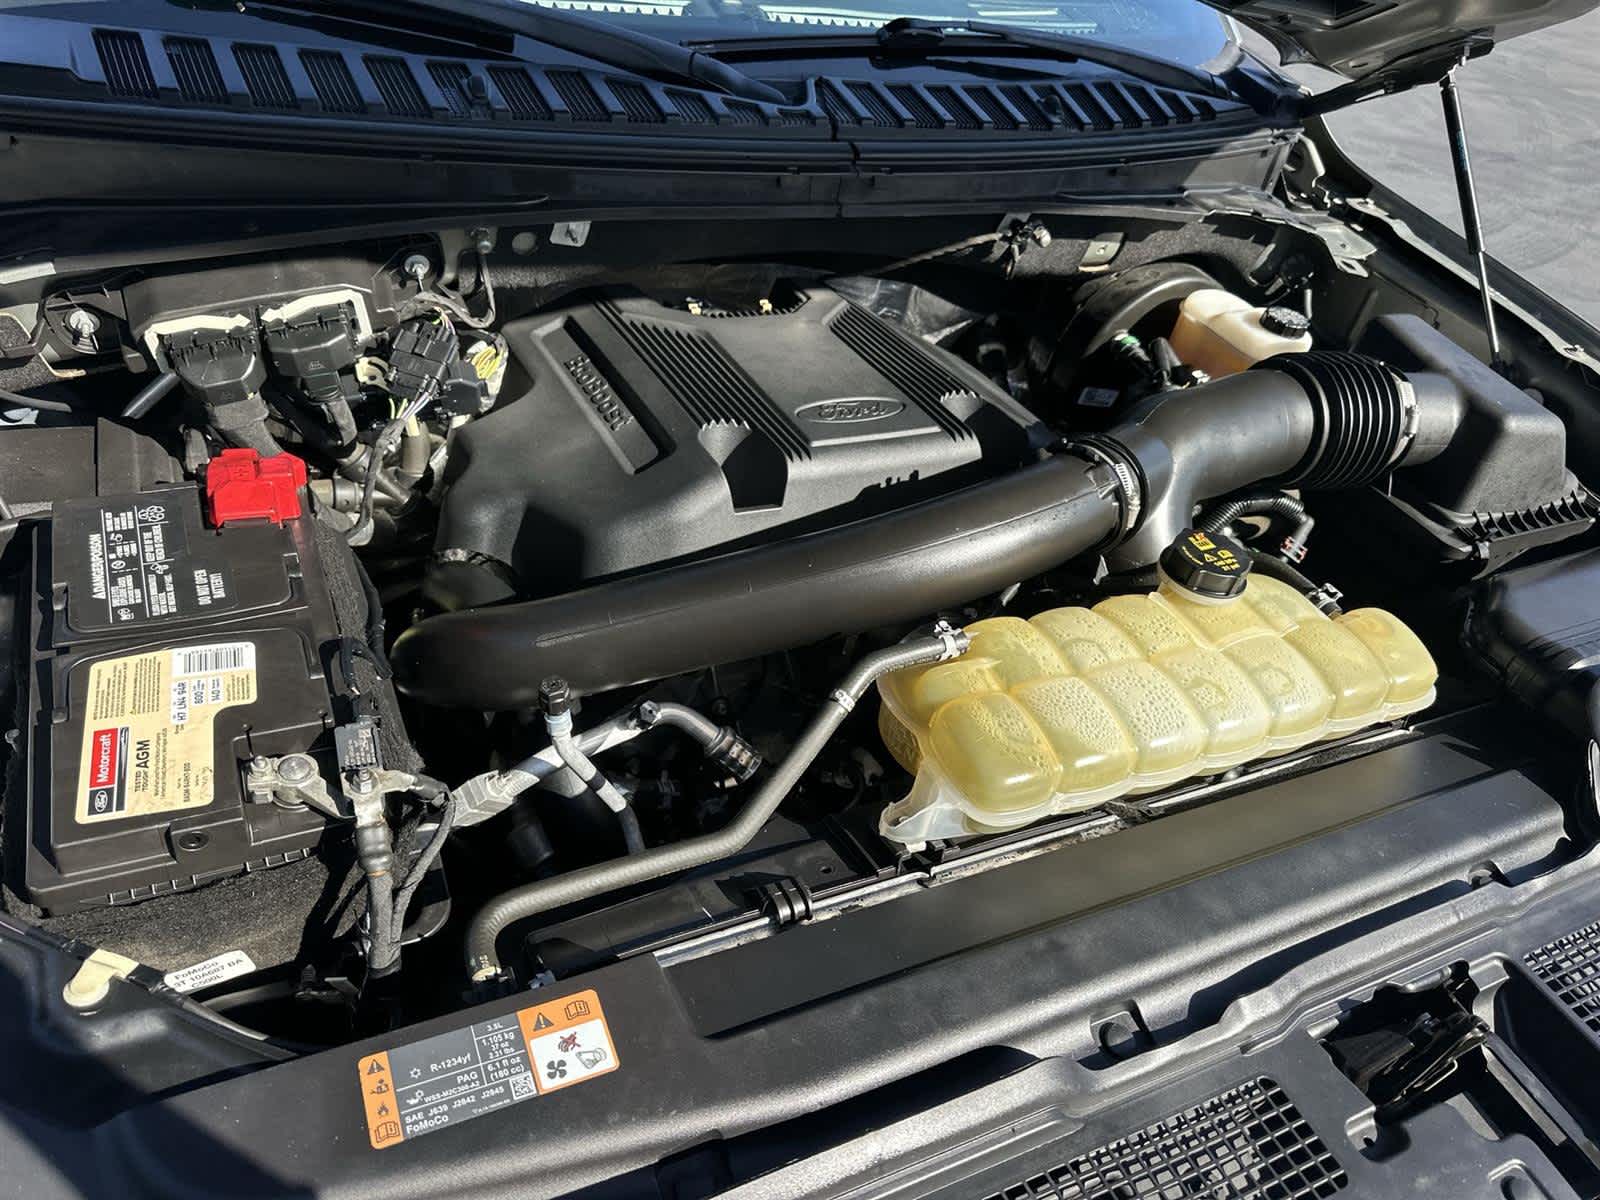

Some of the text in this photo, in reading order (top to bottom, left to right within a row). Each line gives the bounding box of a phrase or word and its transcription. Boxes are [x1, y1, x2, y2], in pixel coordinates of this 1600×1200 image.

[565, 356, 635, 430] EcoBoost
[818, 402, 889, 421] Ford
[176, 711, 187, 721] H7
[96, 732, 112, 783] Motorcraft
[135, 739, 151, 769] AGM
[134, 770, 142, 793] TESTED
[173, 961, 219, 980] FoMoCo
[503, 1032, 515, 1040] kg
[430, 1052, 471, 1072] R-1234yf
[487, 1062, 501, 1072] 6.1
[510, 1056, 521, 1065] oz
[456, 1071, 478, 1084] PAG
[490, 1063, 525, 1082] (180 cc)
[405, 1111, 425, 1124] SAE
[406, 1115, 449, 1134] FoMoCo
